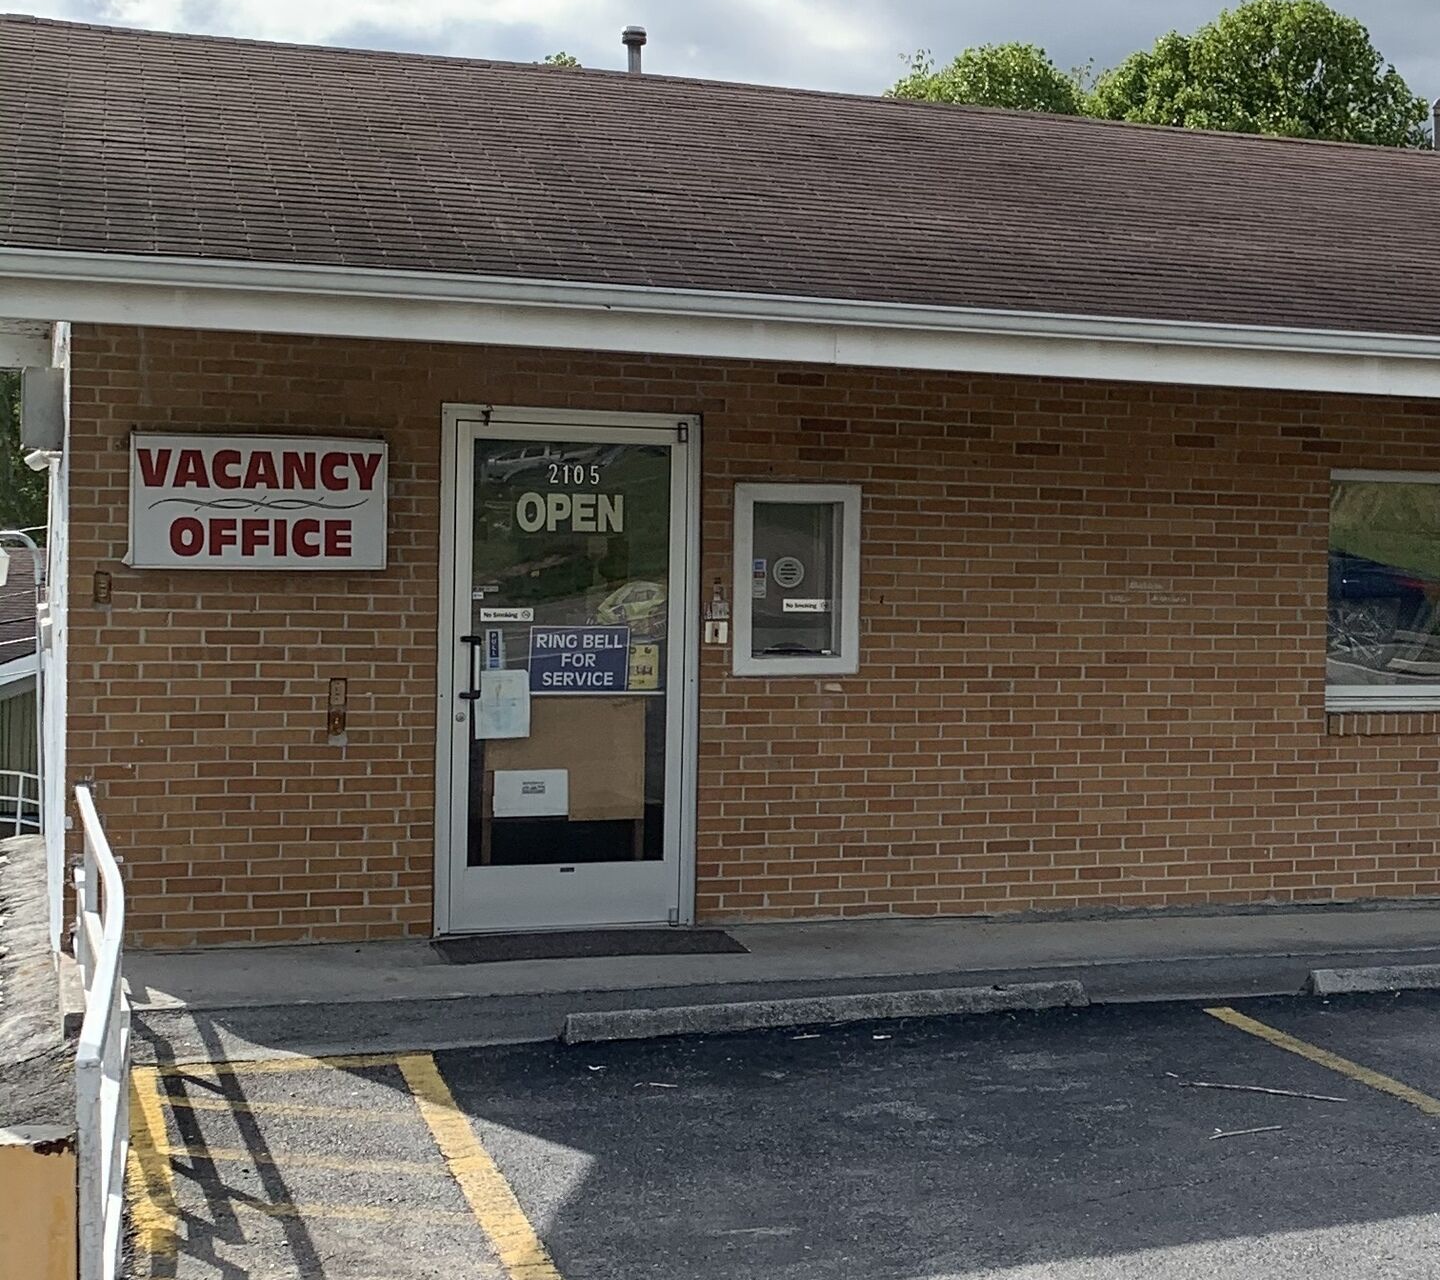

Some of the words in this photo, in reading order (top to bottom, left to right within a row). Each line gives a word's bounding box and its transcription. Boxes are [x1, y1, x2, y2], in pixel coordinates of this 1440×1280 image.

[136, 448, 383, 491] VACANCY
[548, 463, 600, 485] 2105
[516, 491, 624, 533] OPEN
[169, 516, 352, 557] OFFICE
[794, 602, 818, 610] Smoking
[493, 611, 519, 620] Smoking
[536, 633, 578, 648] RING
[582, 633, 623, 649] BELL
[560, 652, 597, 668] FOR
[541, 671, 614, 686] SERVICE
